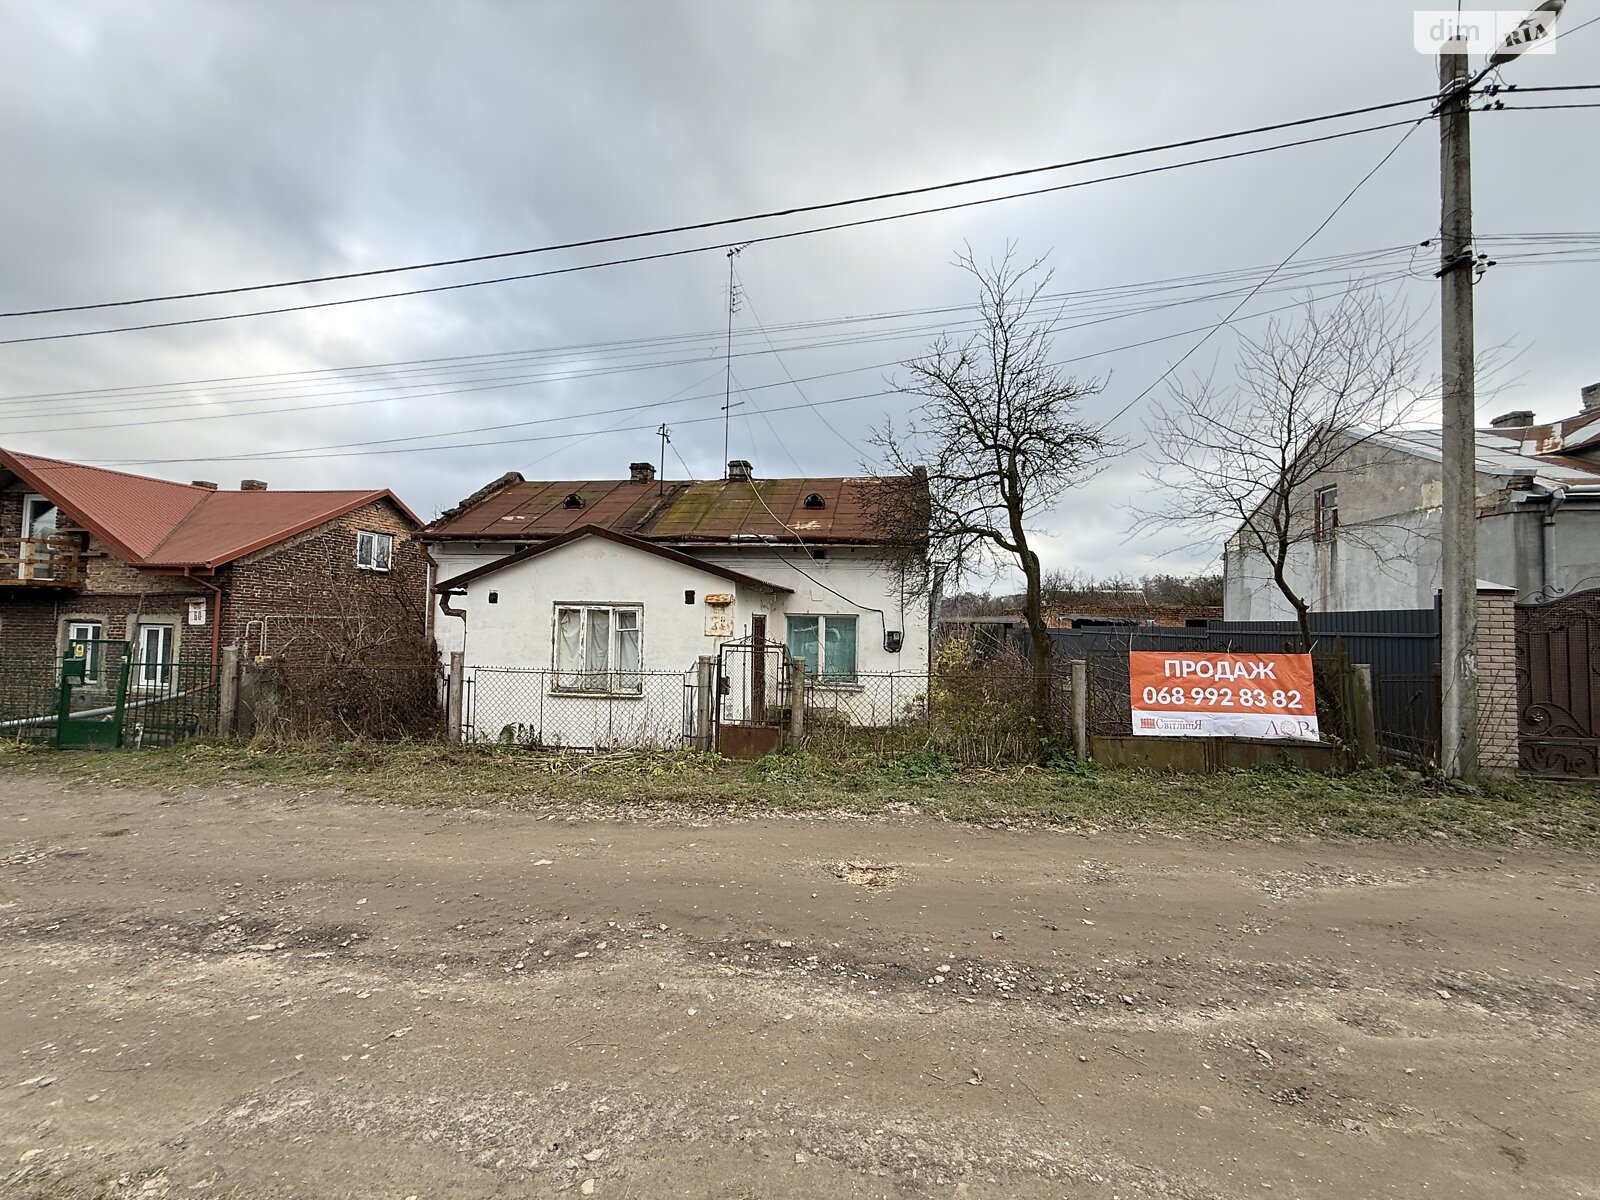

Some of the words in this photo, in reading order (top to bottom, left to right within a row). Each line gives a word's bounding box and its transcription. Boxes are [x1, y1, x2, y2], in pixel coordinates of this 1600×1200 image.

[1164, 659, 1276, 681] ПРОДАЖ
[1142, 686, 1185, 705] 068
[1191, 687, 1234, 706] 992
[1239, 688, 1267, 708] 83
[1272, 689, 1302, 709] 82
